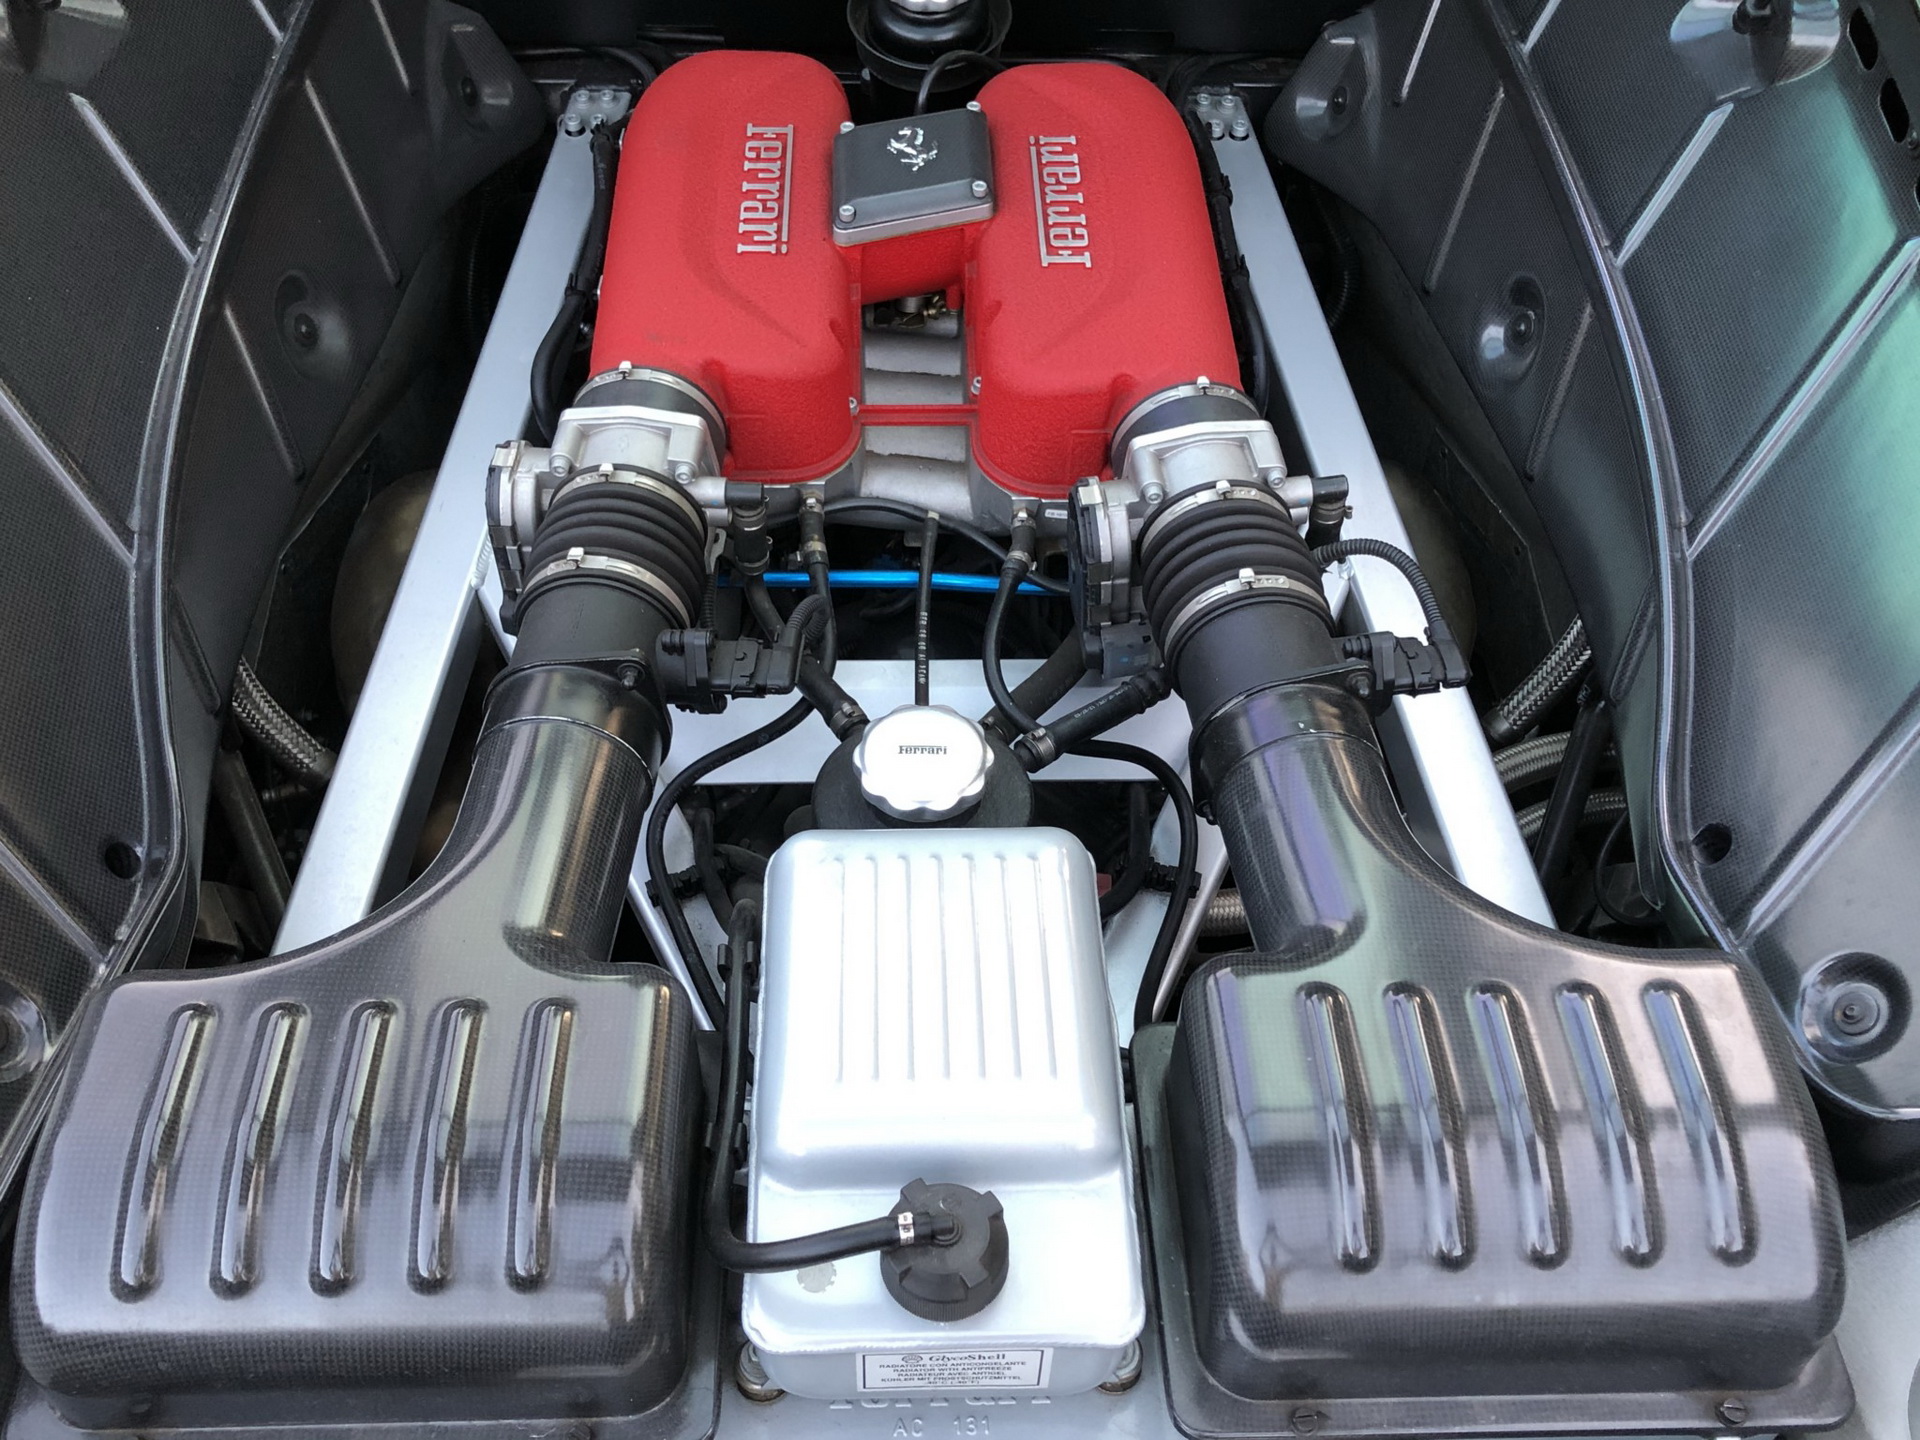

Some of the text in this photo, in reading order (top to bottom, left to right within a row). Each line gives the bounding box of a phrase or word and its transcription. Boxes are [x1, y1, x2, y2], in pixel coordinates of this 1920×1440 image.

[736, 122, 794, 254] Ferrari
[1029, 135, 1092, 268] Ferrari
[898, 745, 947, 754] Ferrari
[929, 1354, 1006, 1362] GlycoShell
[893, 1415, 990, 1437] AC 131
